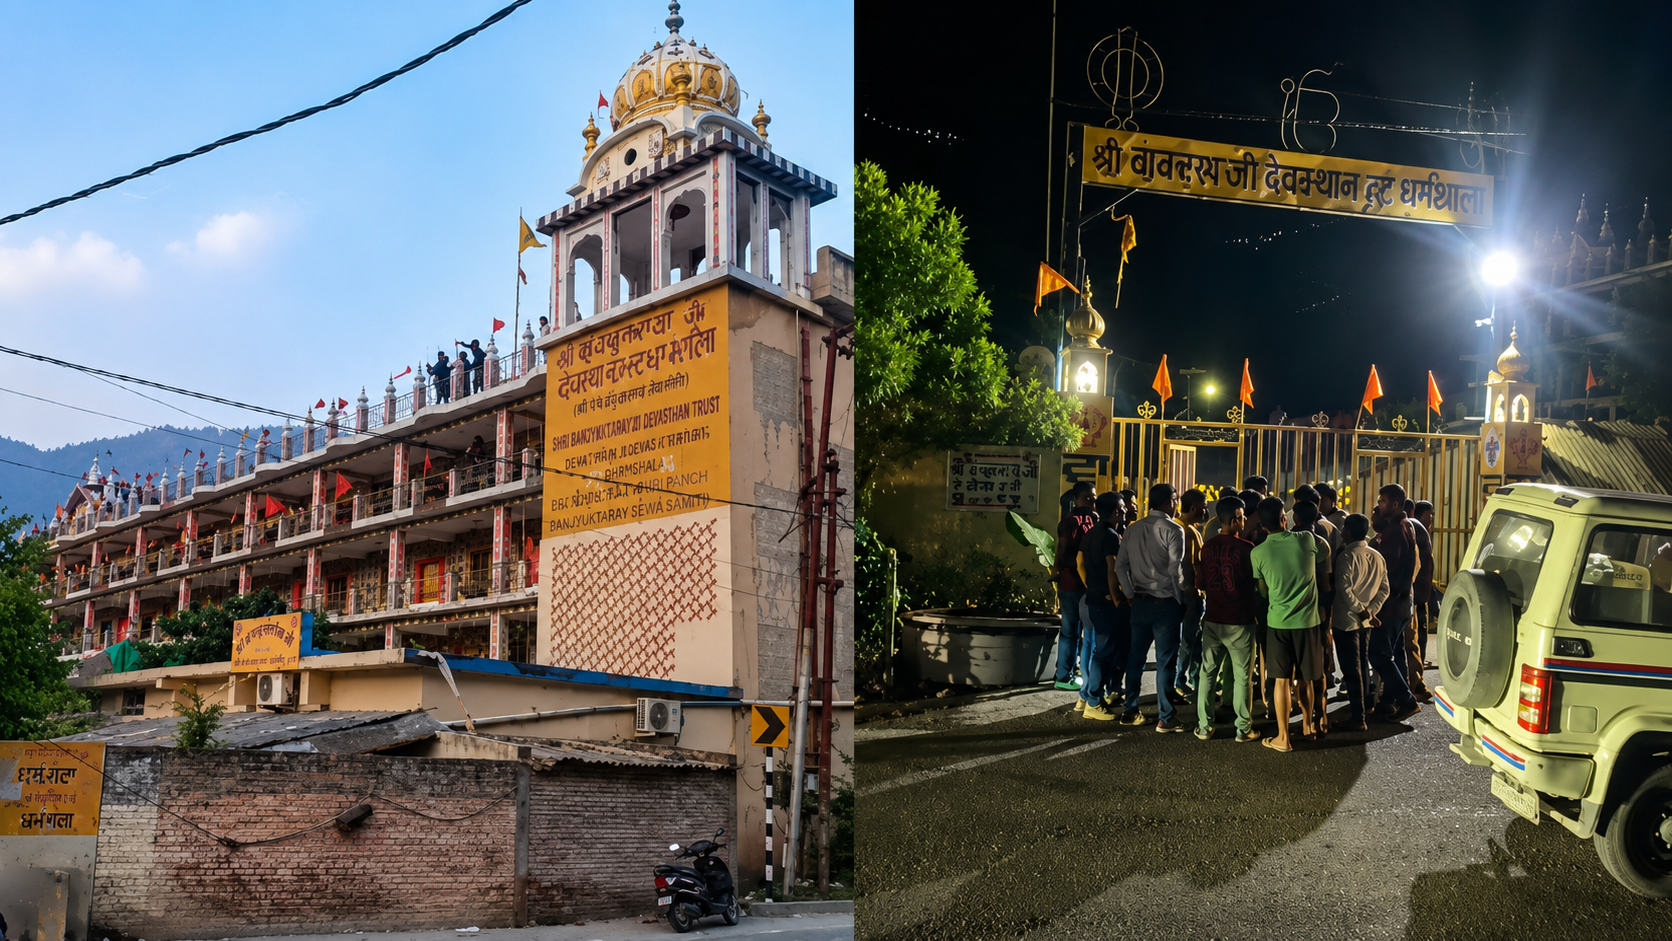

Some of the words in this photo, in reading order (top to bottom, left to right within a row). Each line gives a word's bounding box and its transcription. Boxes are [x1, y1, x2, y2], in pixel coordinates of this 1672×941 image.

[1092, 137, 1124, 177] श्री
[1224, 151, 1259, 192] जी
[556, 342, 574, 370] श्री
[552, 433, 570, 452] SHRI
[692, 395, 720, 418] TRUST
[666, 469, 708, 489] PANCH
